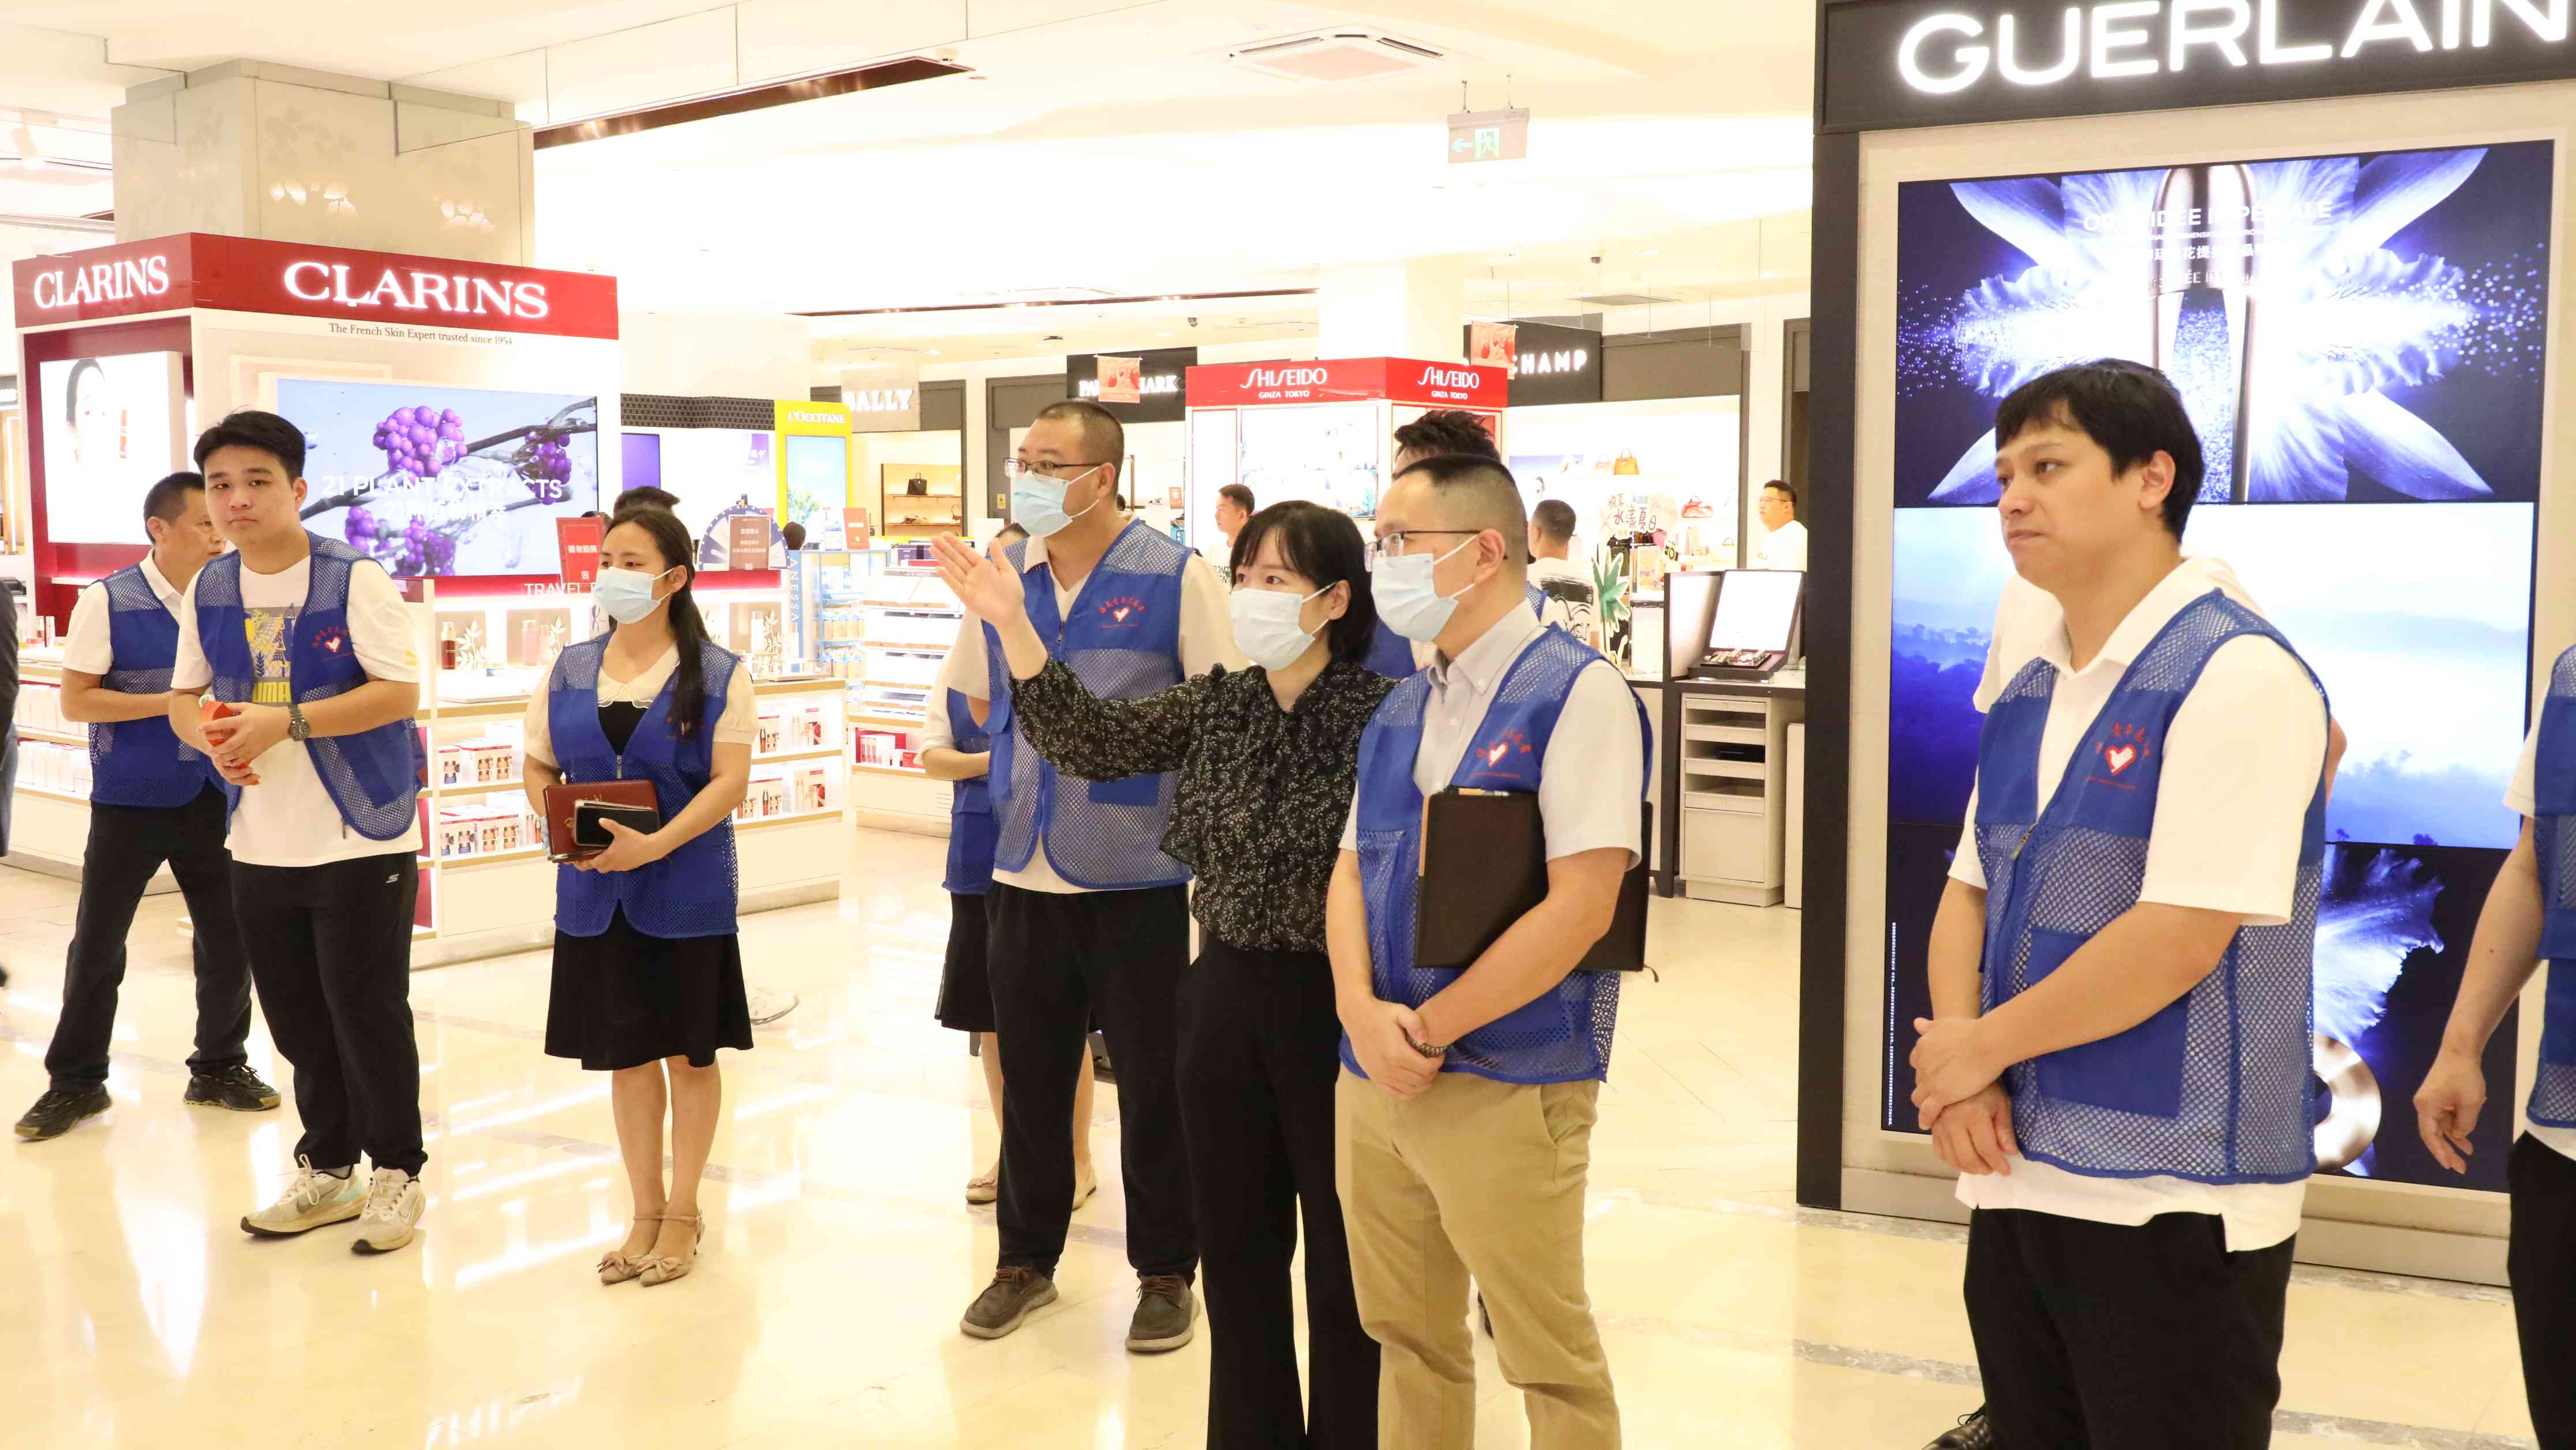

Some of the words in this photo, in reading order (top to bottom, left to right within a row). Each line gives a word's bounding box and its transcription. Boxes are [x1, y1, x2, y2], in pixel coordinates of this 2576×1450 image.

[1898, 0, 2567, 94] GUERLAIN
[33, 256, 169, 309] CLARINS
[283, 261, 548, 318] CLARINS
[329, 323, 347, 333] The
[350, 324, 382, 336] French
[385, 327, 405, 338] Skin
[407, 328, 436, 341] Expert
[439, 332, 468, 342] trusted
[471, 335, 492, 345] since
[495, 337, 512, 345] 1954
[1240, 368, 1327, 388] SHISEIDO
[1417, 367, 1480, 388] SHISEIDO
[842, 389, 913, 411] BALLY
[787, 411, 845, 424] L'OCCITANE
[321, 475, 345, 496] 21
[353, 475, 435, 496] PLANT
[443, 478, 562, 498] EXTRACTS
[524, 583, 582, 595] TRAVEL
[790, 558, 799, 622] ANESSA
[252, 682, 291, 702] UMA
